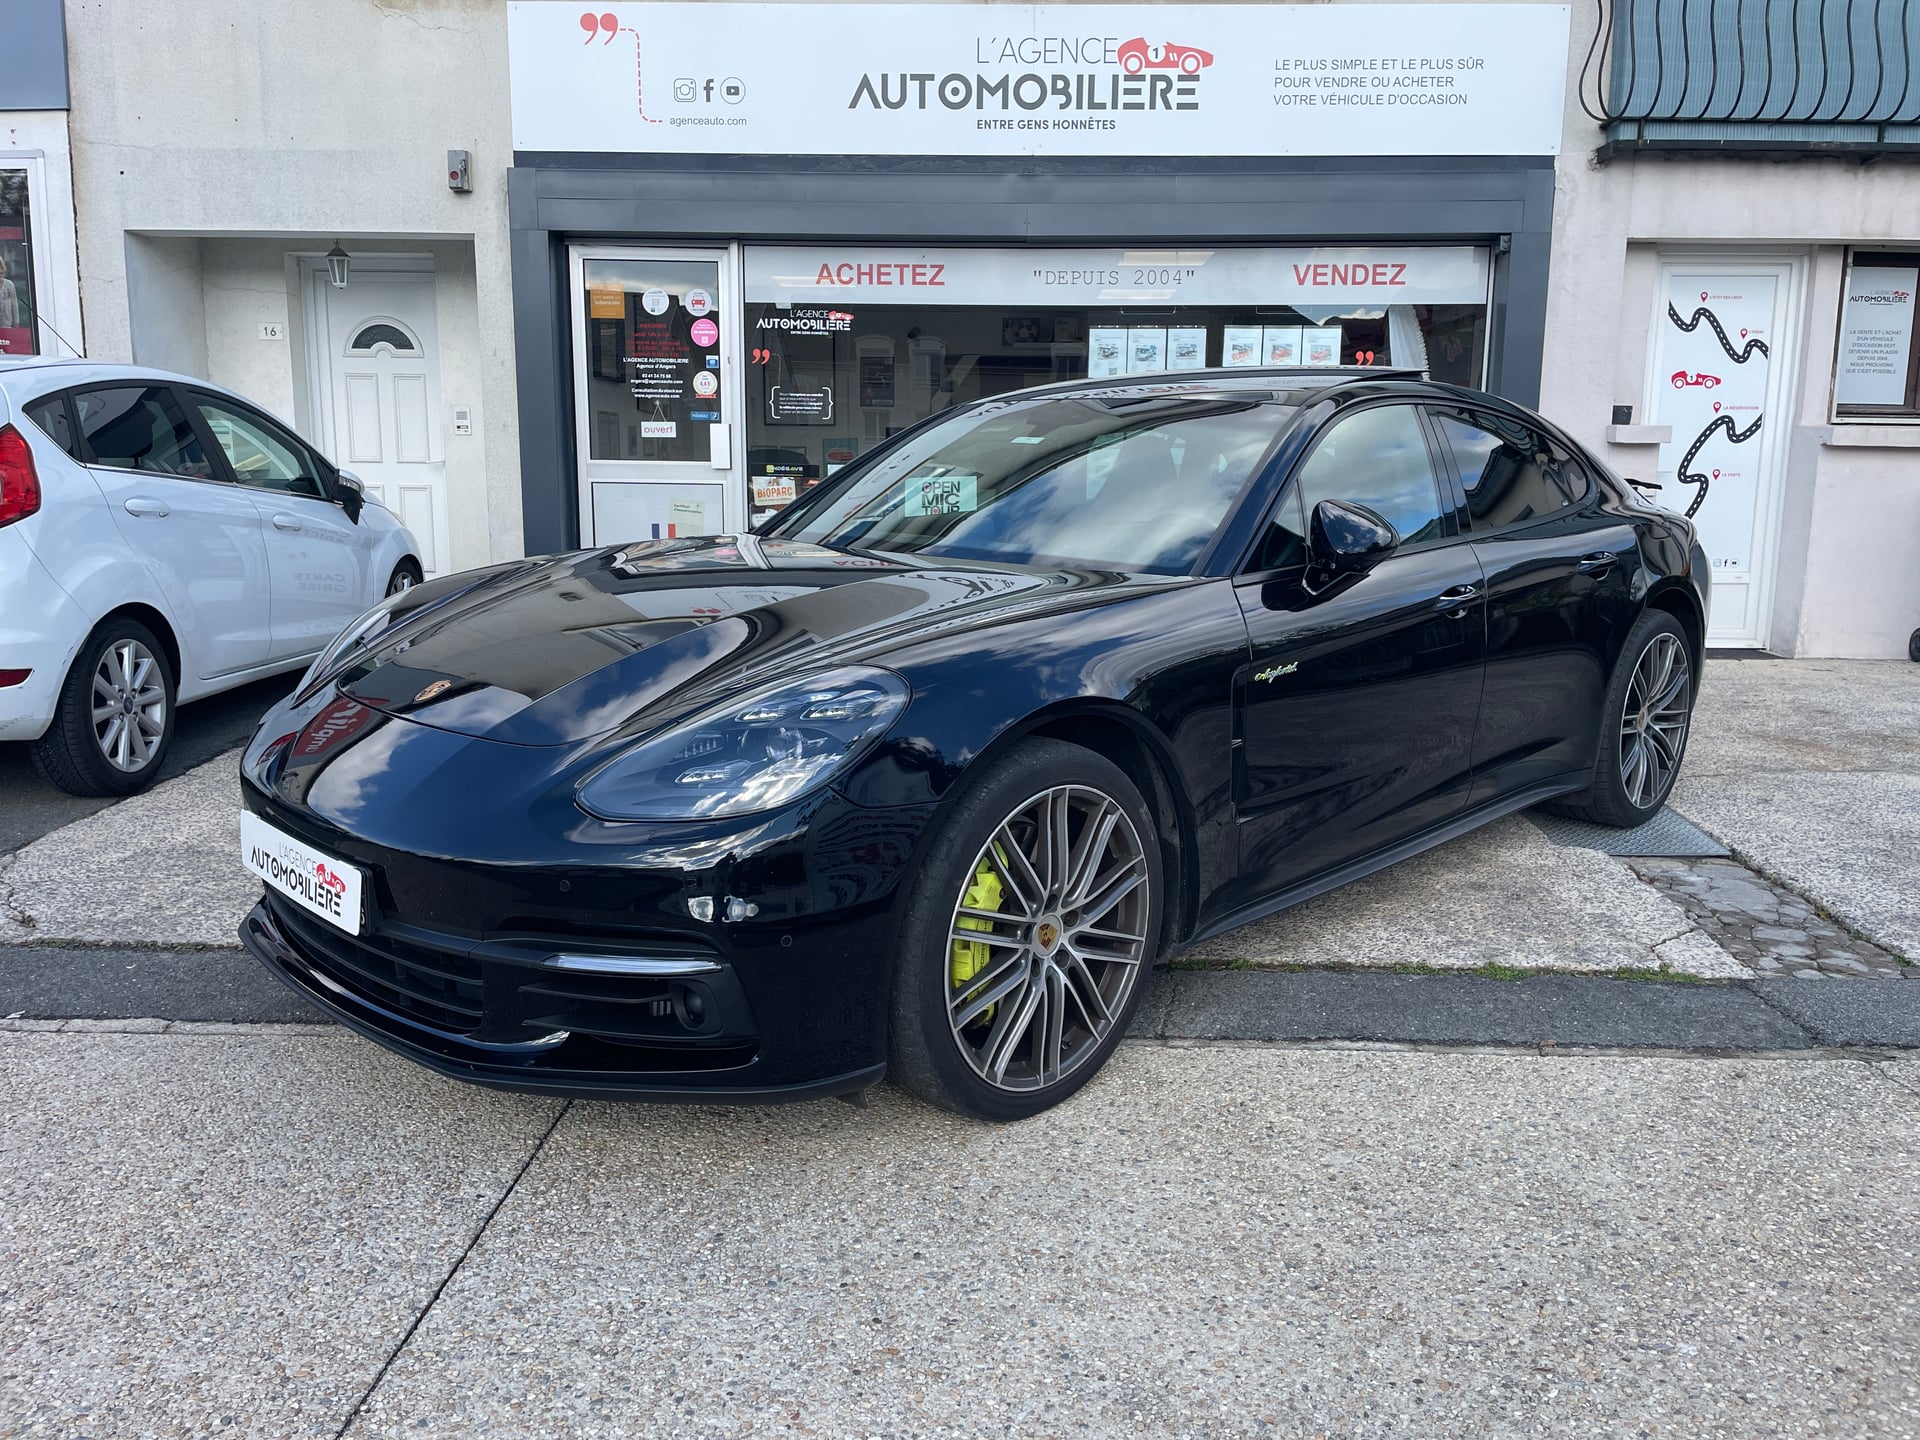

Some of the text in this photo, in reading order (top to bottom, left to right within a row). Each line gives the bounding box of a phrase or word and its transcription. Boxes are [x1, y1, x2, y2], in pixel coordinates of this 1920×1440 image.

[977, 37, 1118, 64] L'AGENCE
[1275, 56, 1485, 71] LE PLUS SIMPLE ET LE PLUS SÛR
[1274, 76, 1454, 88] POUR VENDRE OU ACHETER
[1273, 92, 1468, 106] VOTRE VÉHICULE D'OCCASION
[669, 116, 748, 128] agenceauto.com
[976, 116, 1116, 130] ENTRE GENS HONNÊTES
[816, 262, 945, 286] ACHETEZ
[1292, 263, 1407, 286] VENDEZ
[790, 309, 829, 318] L'AGENCE
[264, 326, 277, 337] 16
[643, 426, 673, 434] ouvert
[921, 480, 960, 494] OPEN
[921, 493, 960, 506] MIC
[279, 841, 317, 878] L'AGENCE
